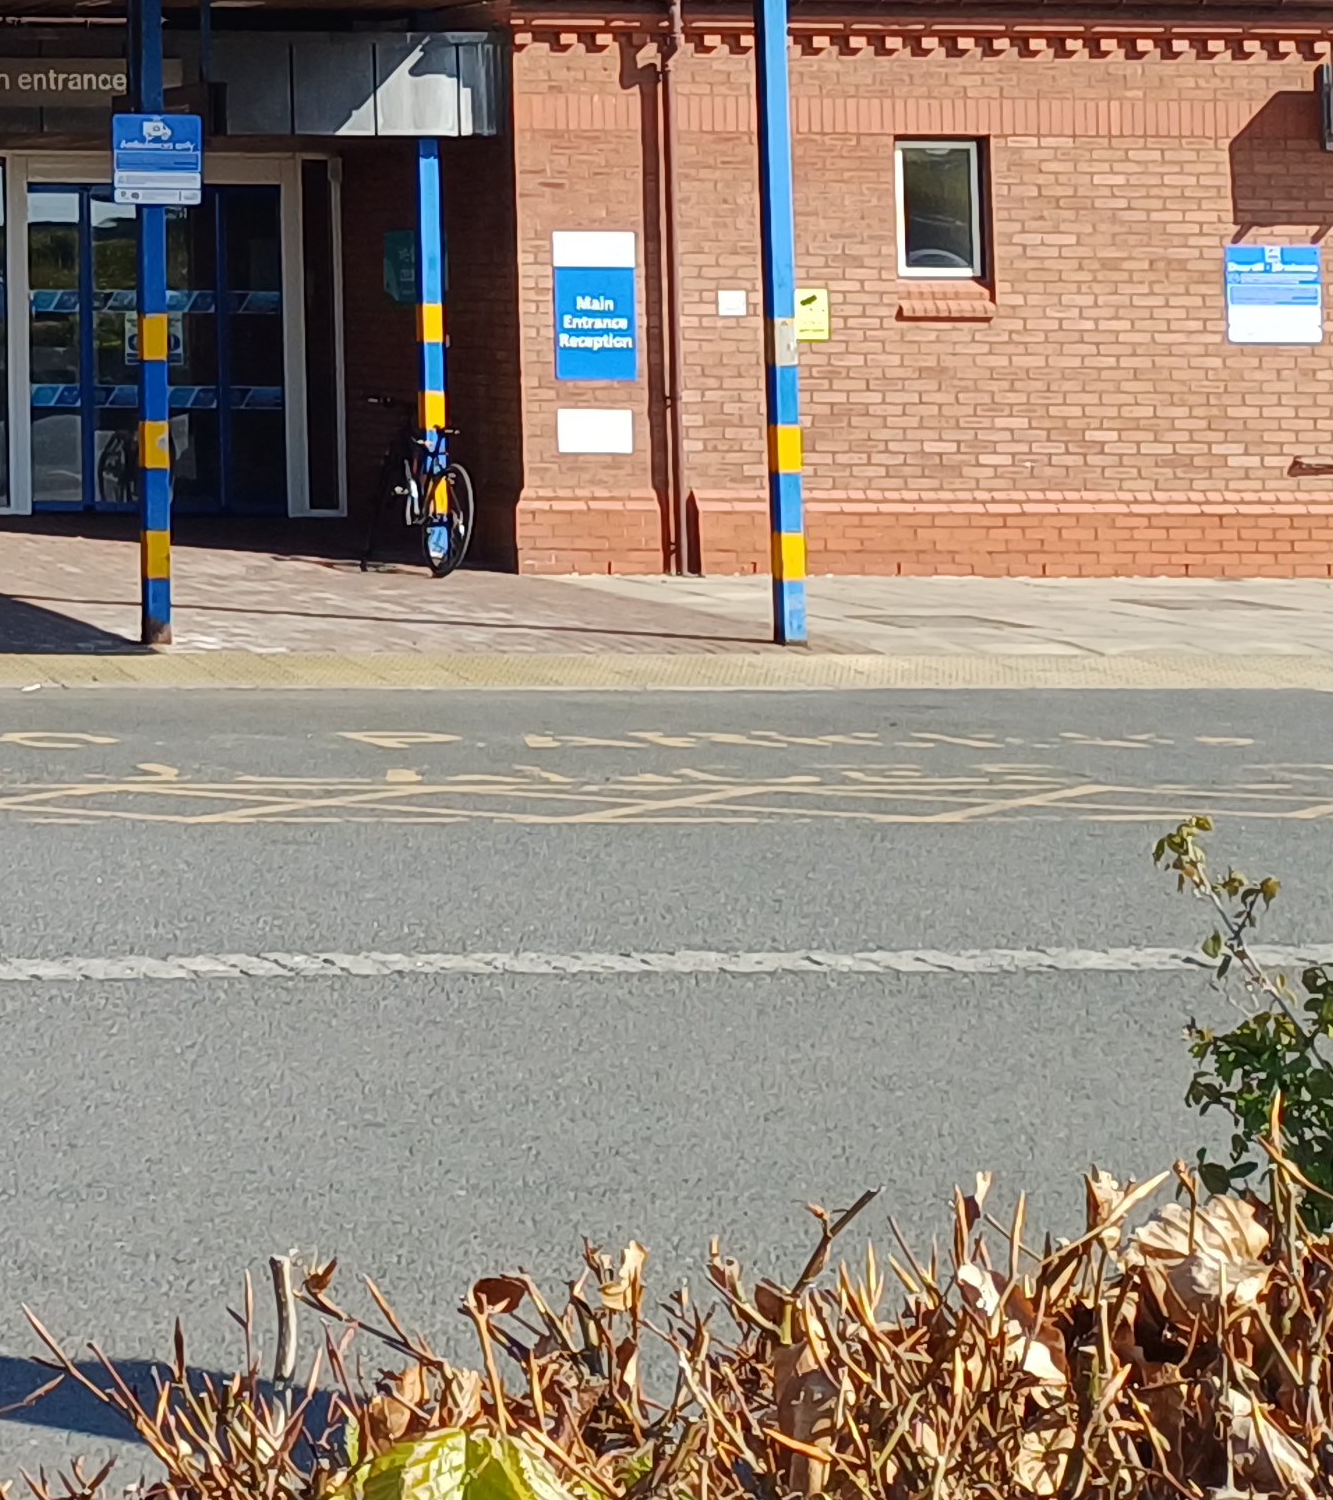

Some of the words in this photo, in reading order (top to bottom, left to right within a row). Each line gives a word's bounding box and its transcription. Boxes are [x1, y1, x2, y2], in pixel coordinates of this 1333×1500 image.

[17, 68, 127, 92] entrance
[576, 296, 614, 311] Main
[563, 315, 628, 330] Entrance
[559, 333, 633, 351] Reception
